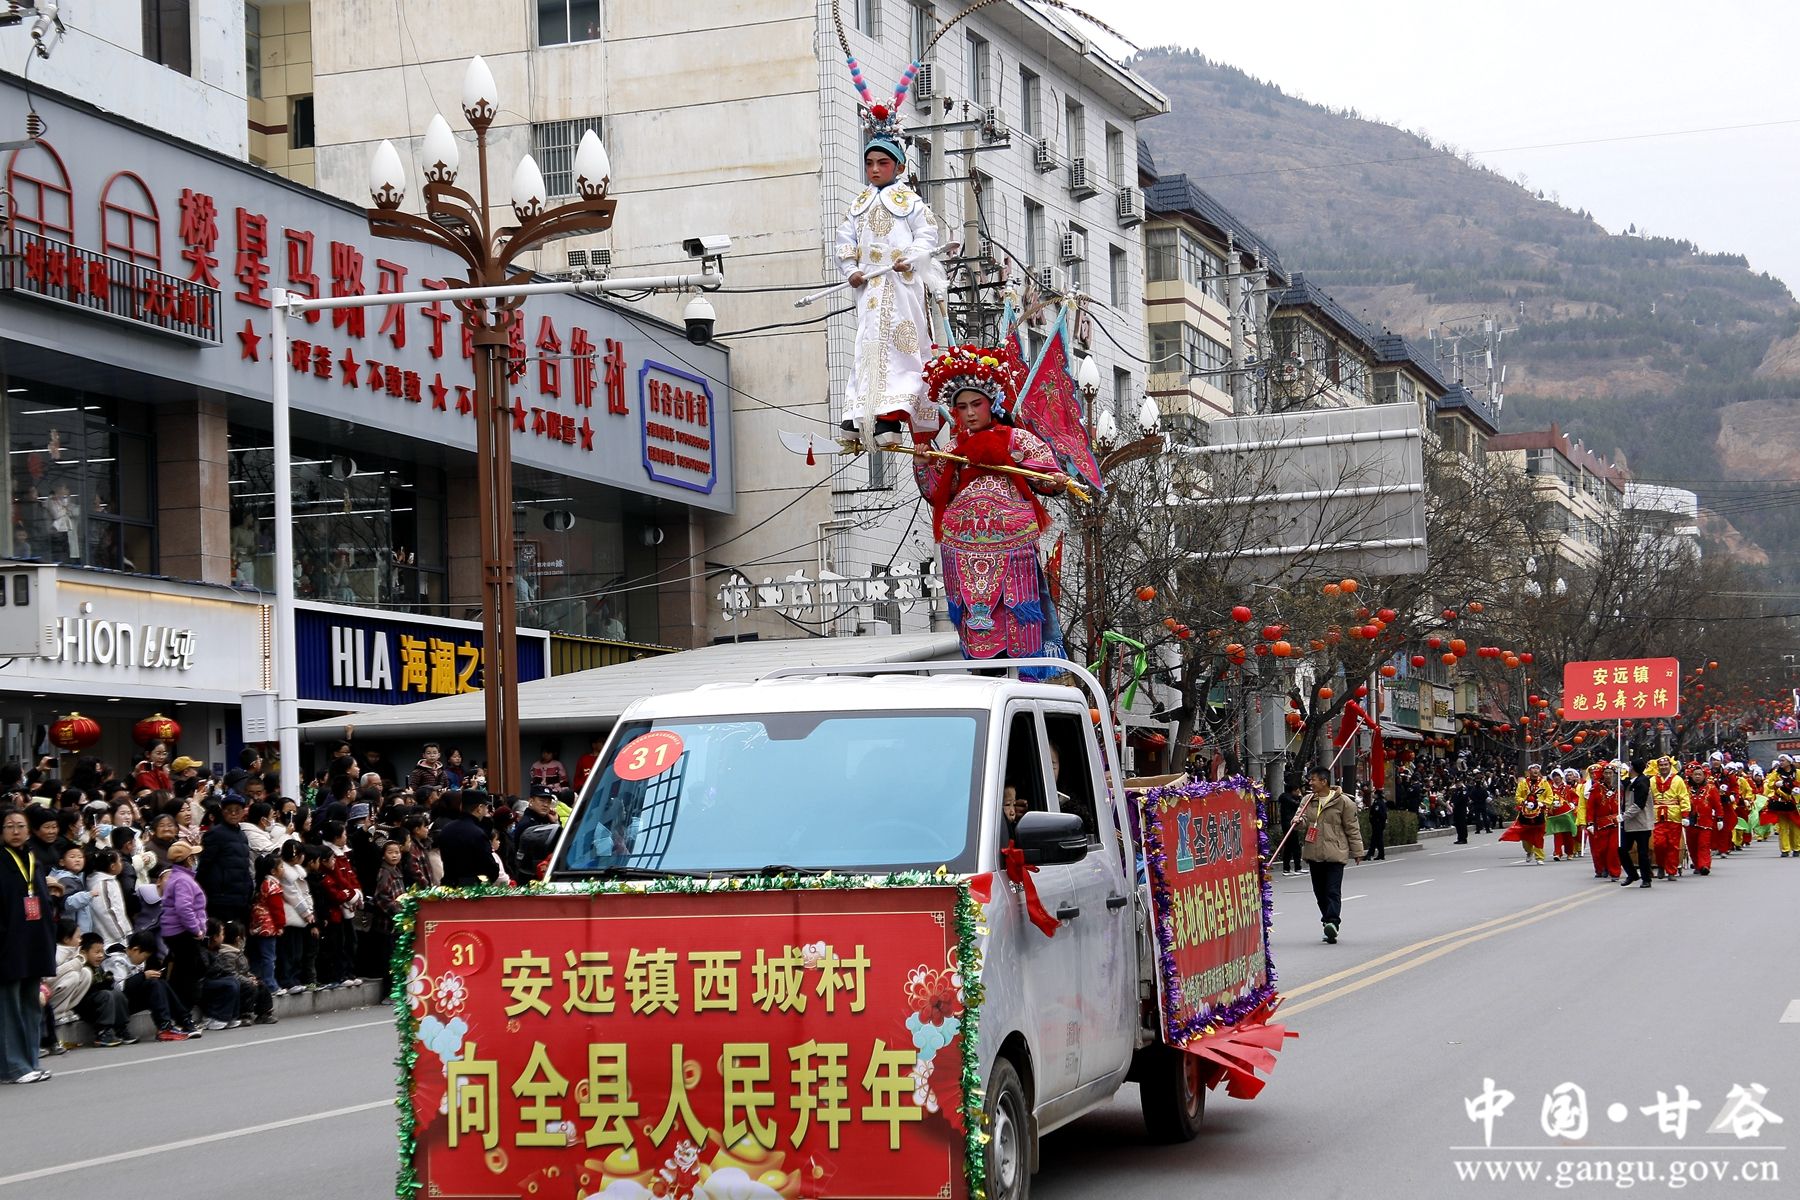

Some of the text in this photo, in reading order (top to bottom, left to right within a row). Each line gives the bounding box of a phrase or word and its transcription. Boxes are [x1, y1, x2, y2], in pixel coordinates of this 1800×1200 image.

[331, 626, 491, 695] HLA 海澜之
[1592, 665, 1649, 686] 安远镇
[1572, 687, 1669, 712] 跑马舞方阵
[628, 743, 669, 770] 31
[1193, 809, 1244, 867] 圣象地板
[451, 943, 475, 967] 31
[502, 944, 871, 1016] 安远镇西城村
[447, 1038, 922, 1150] 向全县人民拜年
